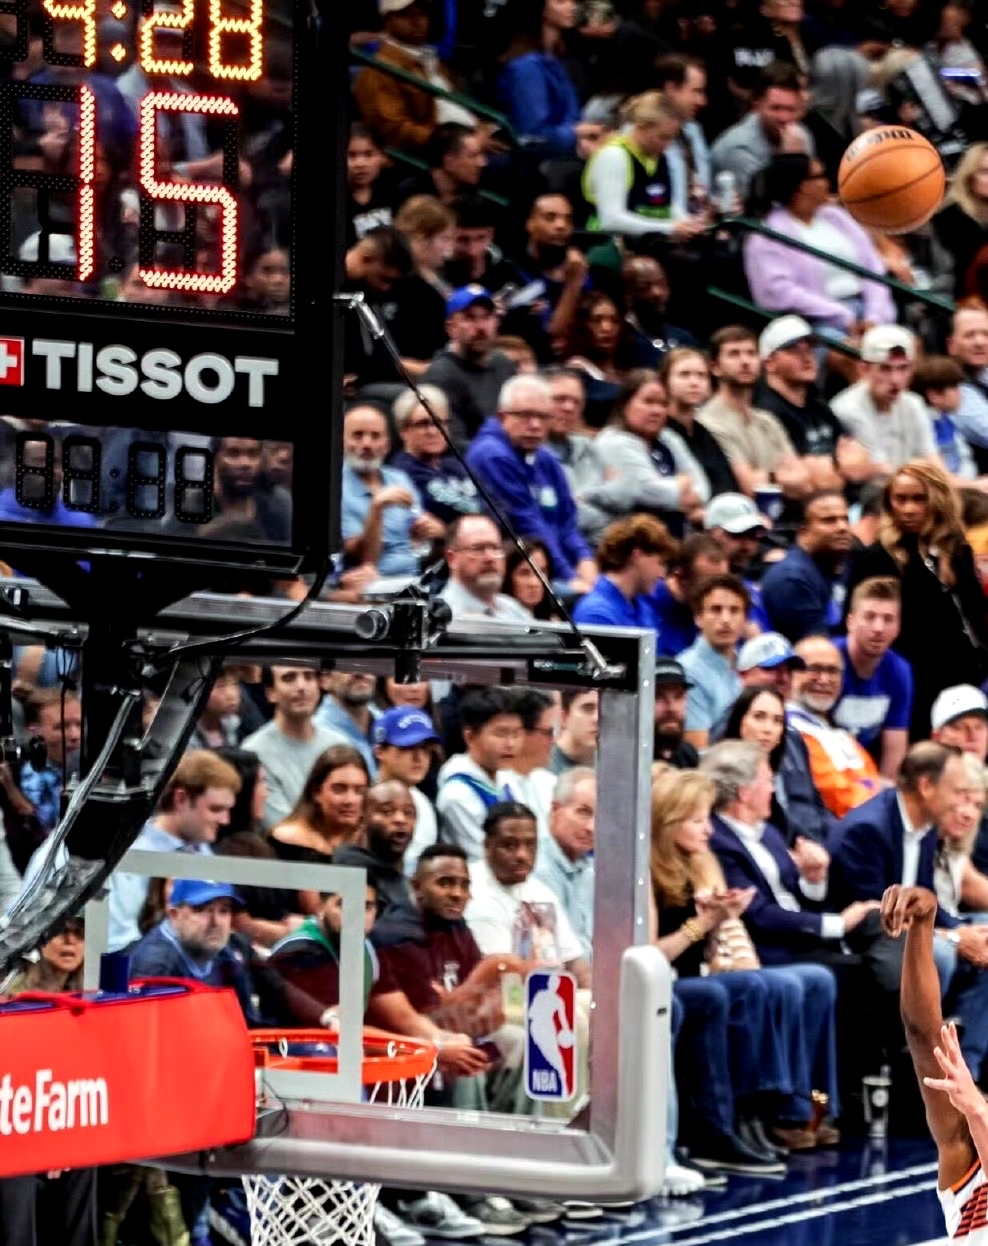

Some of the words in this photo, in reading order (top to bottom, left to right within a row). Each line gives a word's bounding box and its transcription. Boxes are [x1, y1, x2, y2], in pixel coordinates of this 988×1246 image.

[80, 84, 239, 294] 15
[32, 338, 279, 407] TISSOT
[532, 1069, 558, 1093] NBA
